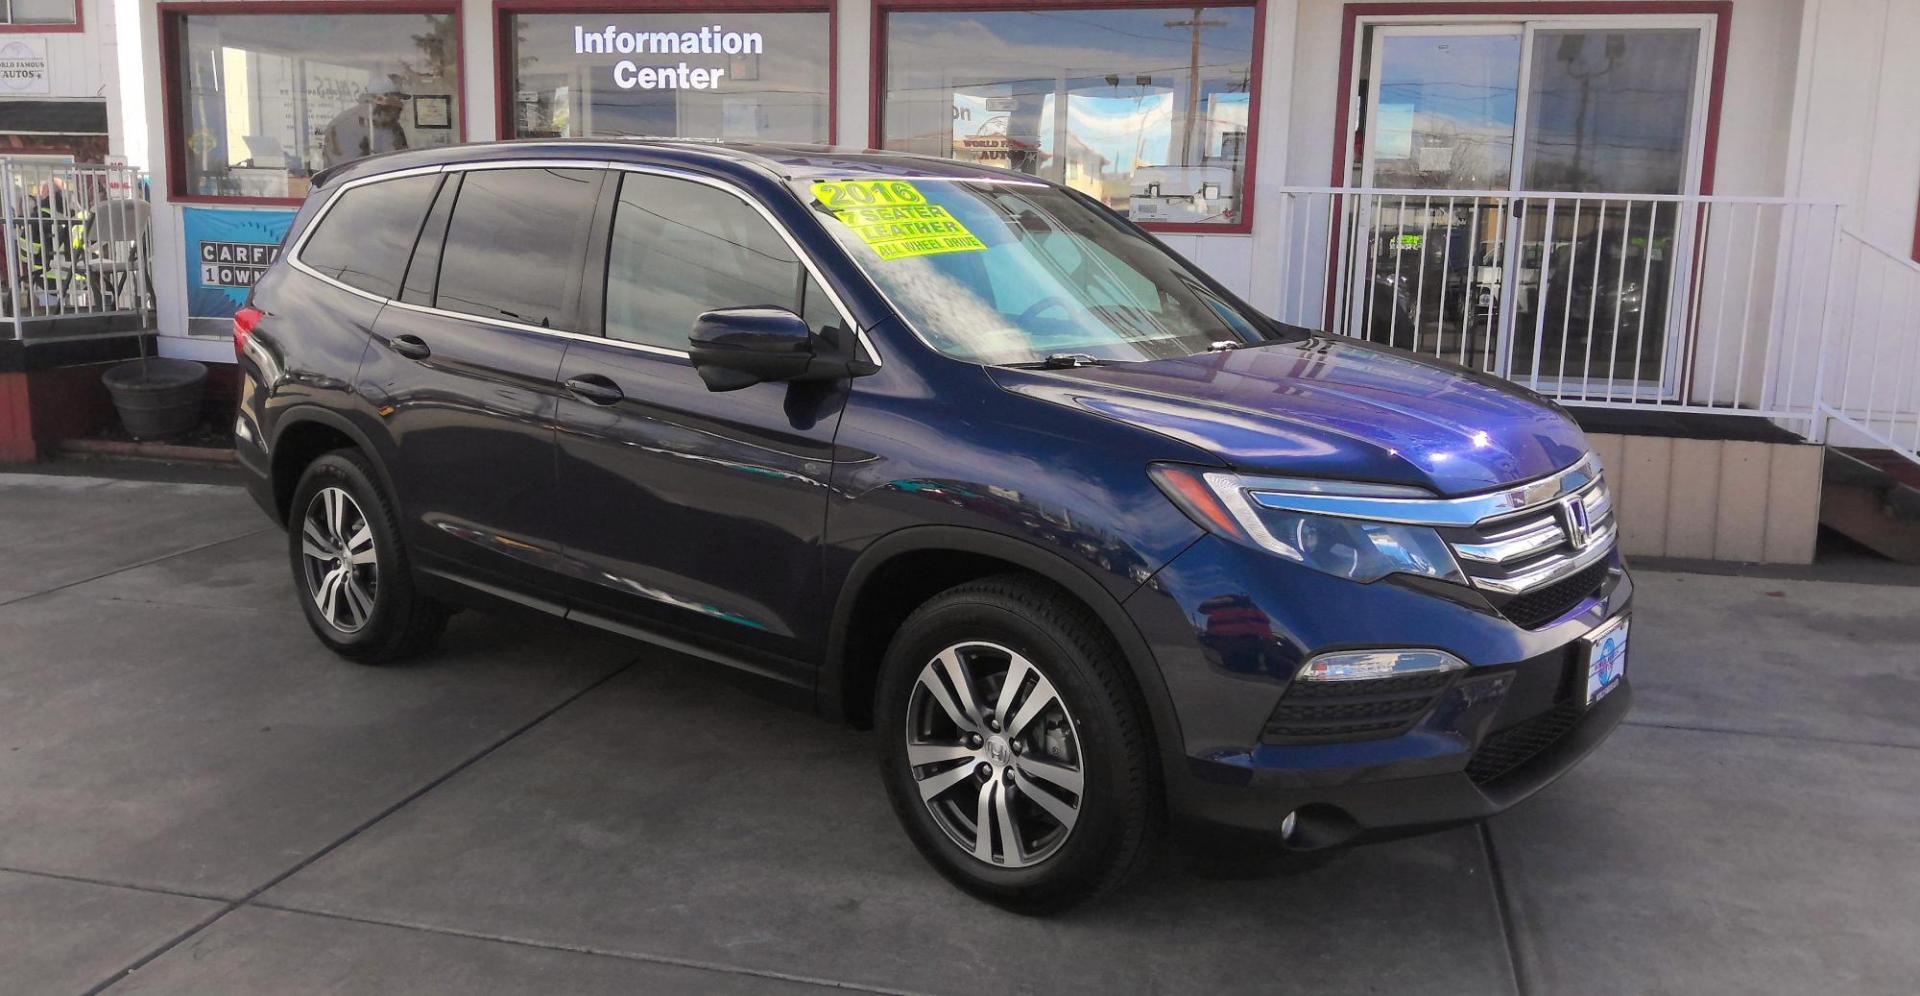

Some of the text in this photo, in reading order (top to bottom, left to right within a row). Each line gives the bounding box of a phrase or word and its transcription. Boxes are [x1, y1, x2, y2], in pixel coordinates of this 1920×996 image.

[574, 25, 763, 54] Information
[3, 70, 34, 79] AUTOS
[613, 60, 725, 90] Center
[963, 139, 1000, 148] WORLD
[821, 182, 920, 205] 2016
[837, 206, 946, 225] 7 SEATER
[862, 221, 960, 241] LEATHER
[879, 236, 982, 257] ALL WHEEL DRIVE
[205, 267, 215, 282] 1
